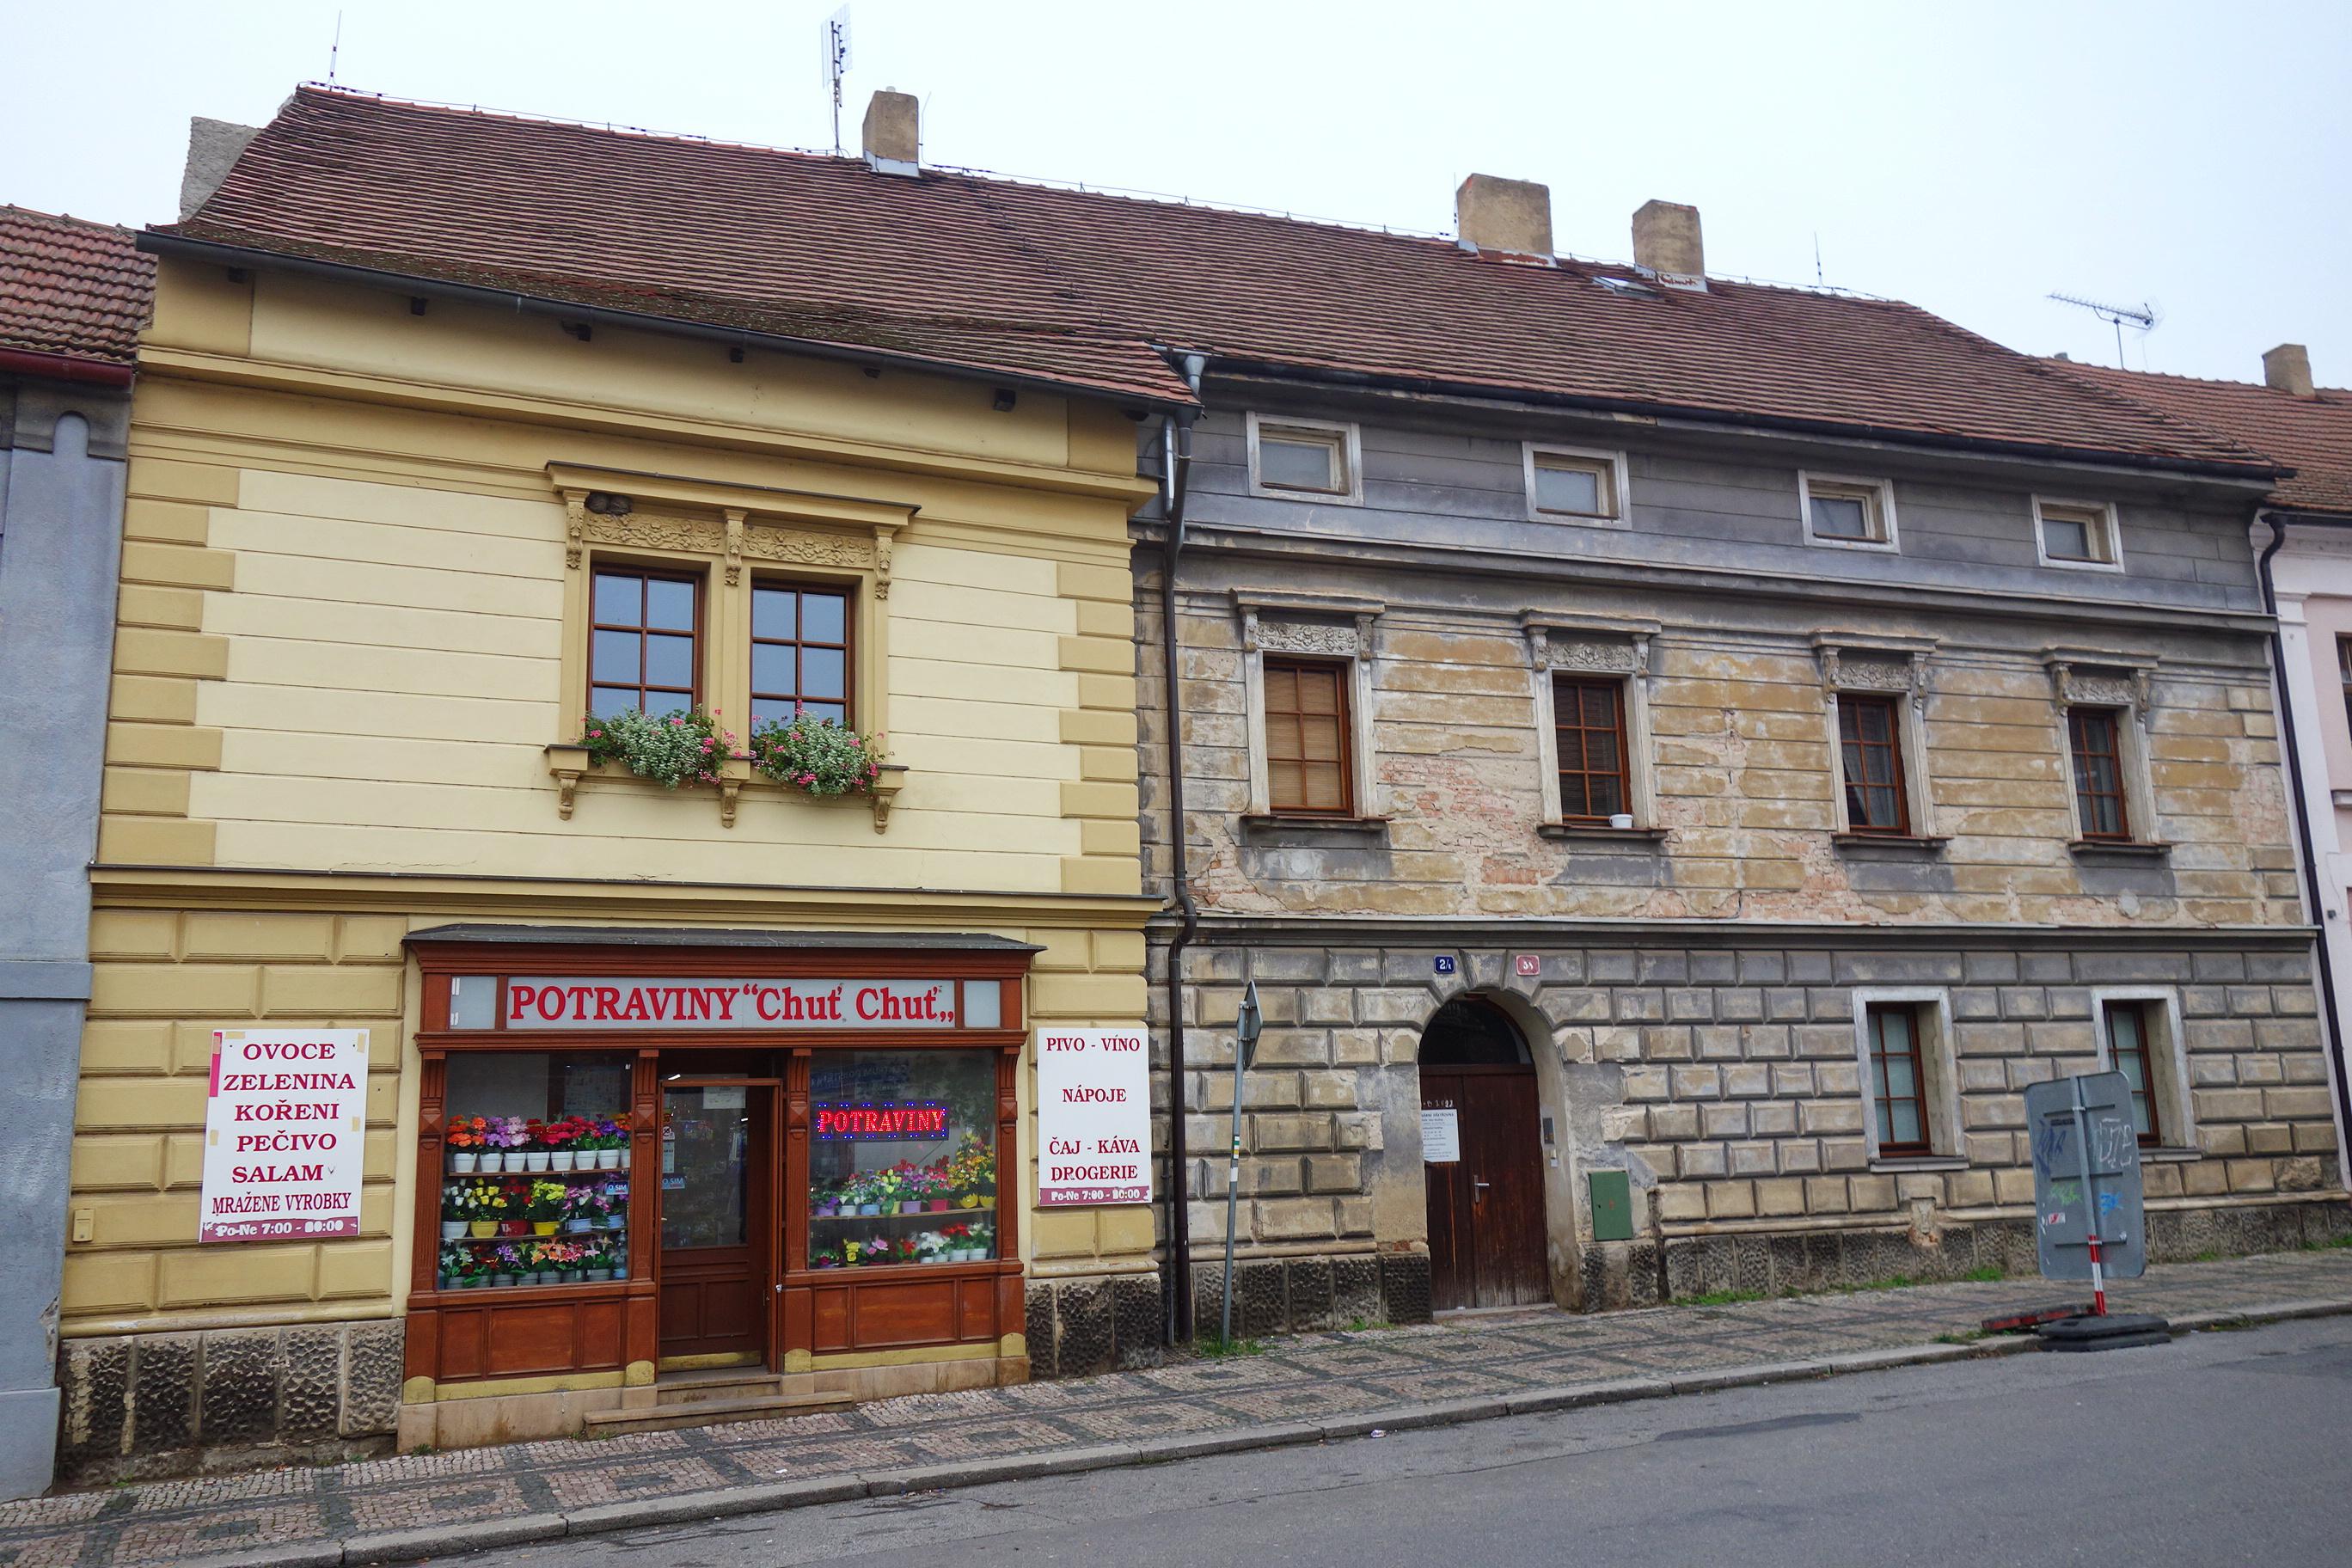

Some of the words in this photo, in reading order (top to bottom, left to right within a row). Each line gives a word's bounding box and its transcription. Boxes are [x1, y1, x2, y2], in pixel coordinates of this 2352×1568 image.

[509, 986, 739, 1020] POTRAVINY
[243, 1044, 336, 1060] OVOCE
[1046, 1038, 1085, 1050] PIVO
[224, 1073, 355, 1091] ZELENINA
[1063, 1085, 1126, 1102] NÁPOJE
[234, 1099, 340, 1121] KOŘENI
[818, 1110, 945, 1133] POTRAVINY
[236, 1130, 337, 1152] PEČIVO
[1049, 1137, 1081, 1155] ČAJ
[1097, 1136, 1140, 1154] KÁVA
[232, 1165, 323, 1183] SALAM
[1050, 1166, 1137, 1181] DROGERIE
[212, 1191, 280, 1214] MRAŽENE
[285, 1192, 352, 1211] VYROBKY
[261, 1222, 293, 1234] 7:00
